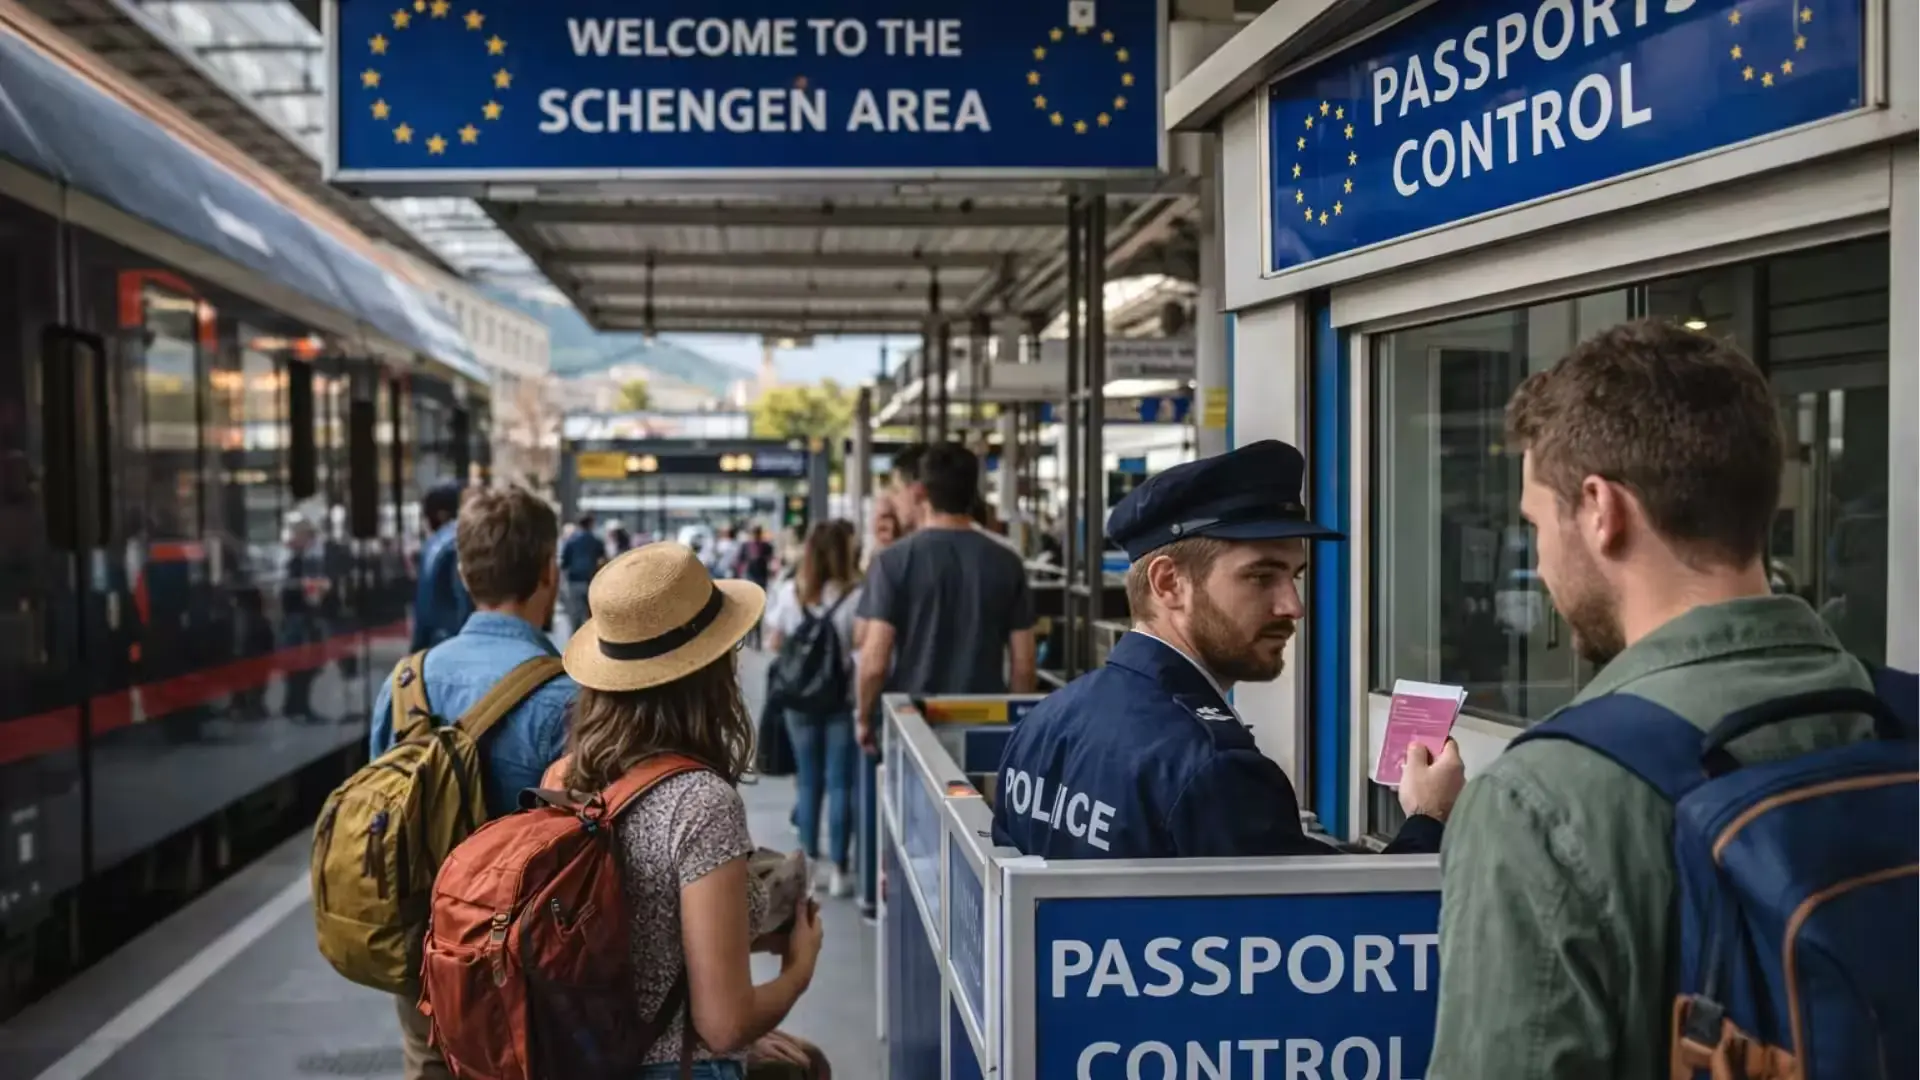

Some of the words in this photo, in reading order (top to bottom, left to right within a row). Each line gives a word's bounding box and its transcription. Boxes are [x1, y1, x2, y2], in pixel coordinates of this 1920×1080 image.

[568, 19, 797, 56] WELCOME
[807, 19, 867, 55] TO
[878, 20, 961, 55] THE
[1373, 0, 1696, 126] PASSPOR
[539, 88, 826, 133] SCHENGEN
[847, 89, 990, 131] AREA
[1393, 63, 1652, 197] CONTROL
[1005, 767, 1117, 852] POLICE
[1052, 933, 1439, 998] PASSPORT
